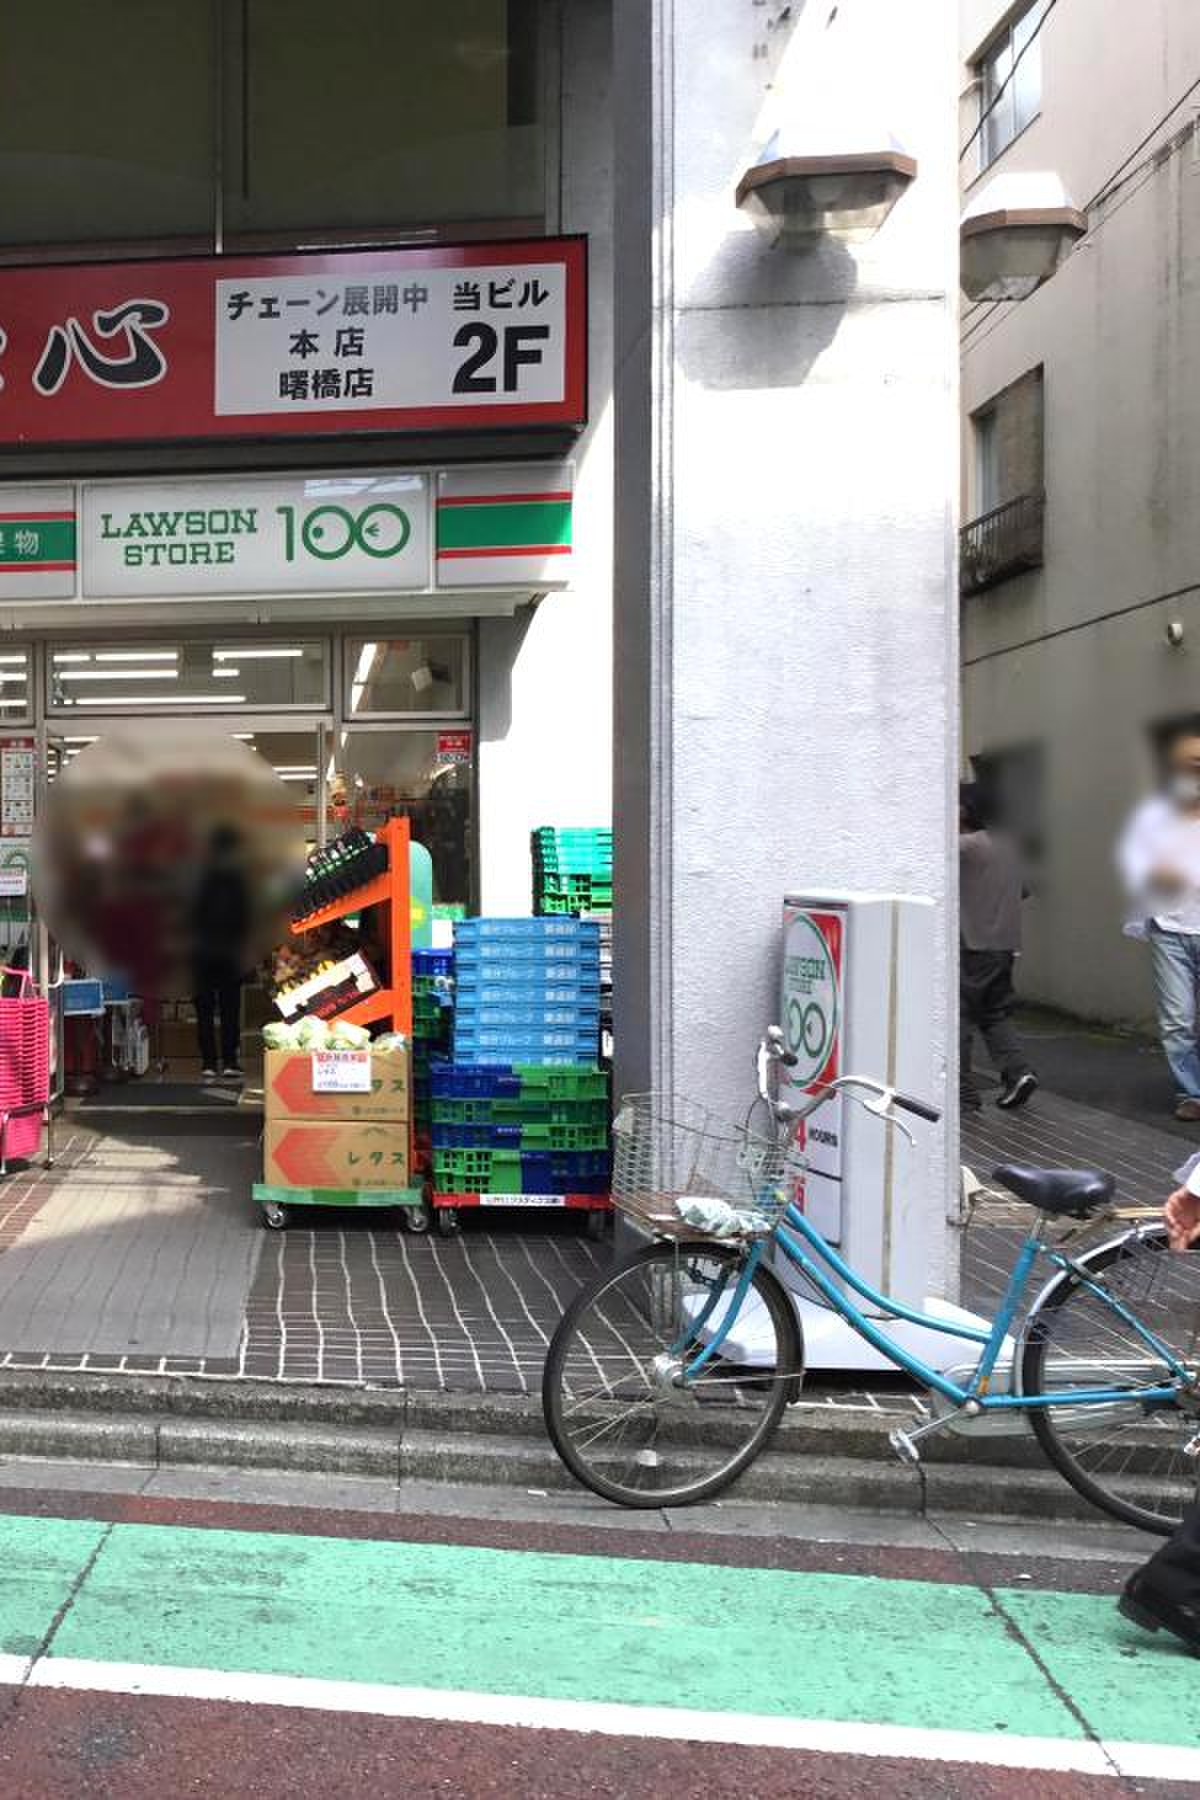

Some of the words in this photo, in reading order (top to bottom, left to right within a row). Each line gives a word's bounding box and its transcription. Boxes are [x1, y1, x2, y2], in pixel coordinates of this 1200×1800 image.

[227, 283, 429, 320] チェーン展開中
[453, 279, 550, 311] 当ビル
[289, 327, 366, 359] 本店
[452, 321, 550, 394] 2F
[278, 368, 375, 400] 曙橋店
[101, 509, 258, 539] LAWSON
[276, 503, 411, 562] 100
[125, 542, 235, 566] STORE
[347, 1151, 404, 1166] レタス
